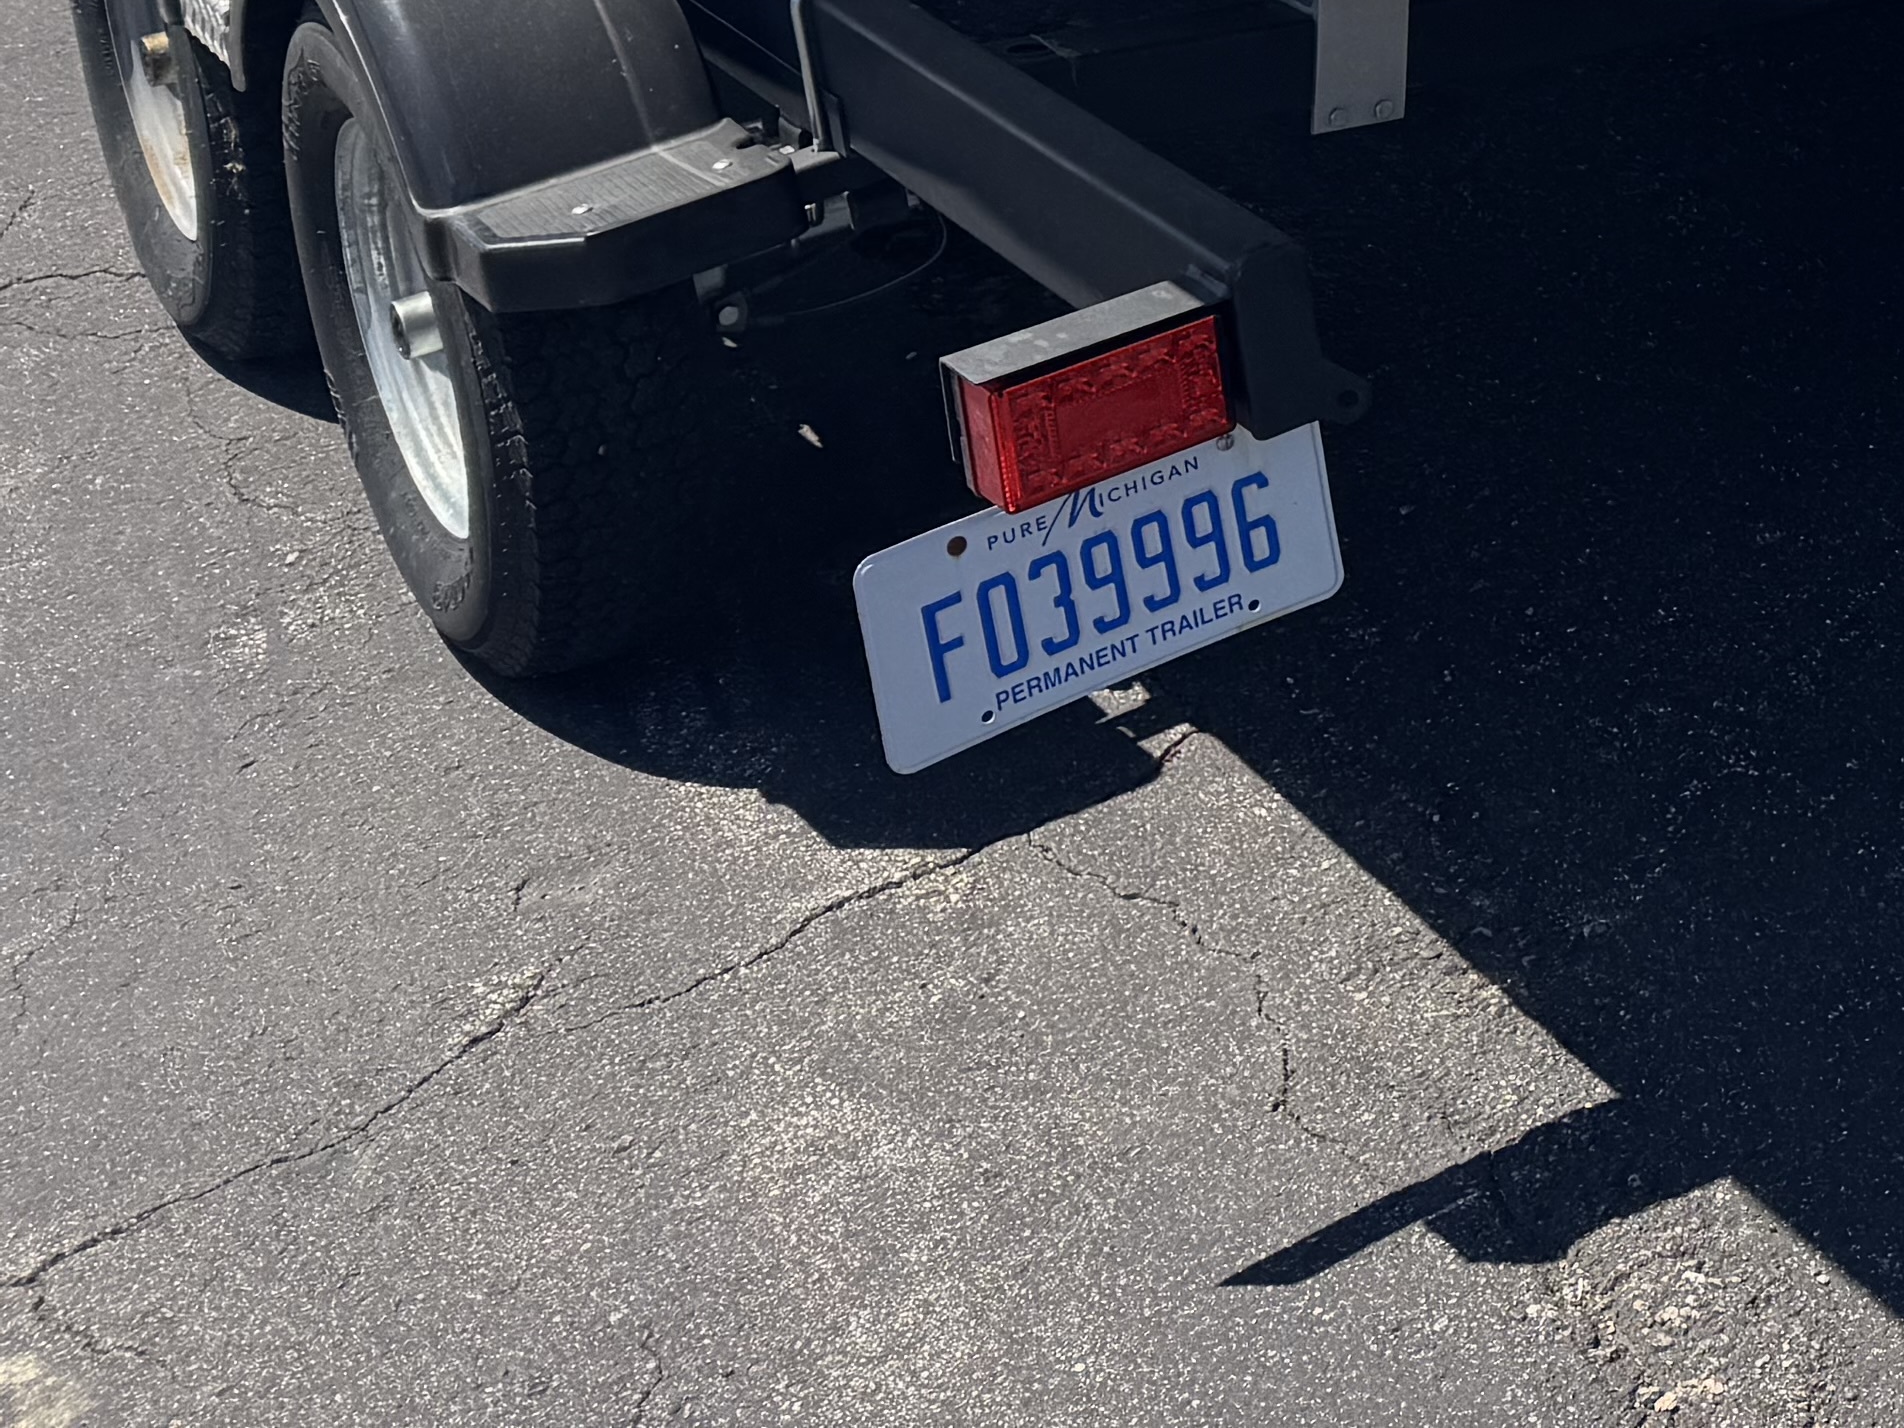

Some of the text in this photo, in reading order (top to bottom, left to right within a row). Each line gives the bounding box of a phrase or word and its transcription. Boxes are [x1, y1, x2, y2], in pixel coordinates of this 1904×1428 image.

[987, 456, 1200, 551] PURE MICHIGAN
[921, 472, 1281, 704] F039996
[994, 593, 1245, 712] PERMANENT TRAILER
